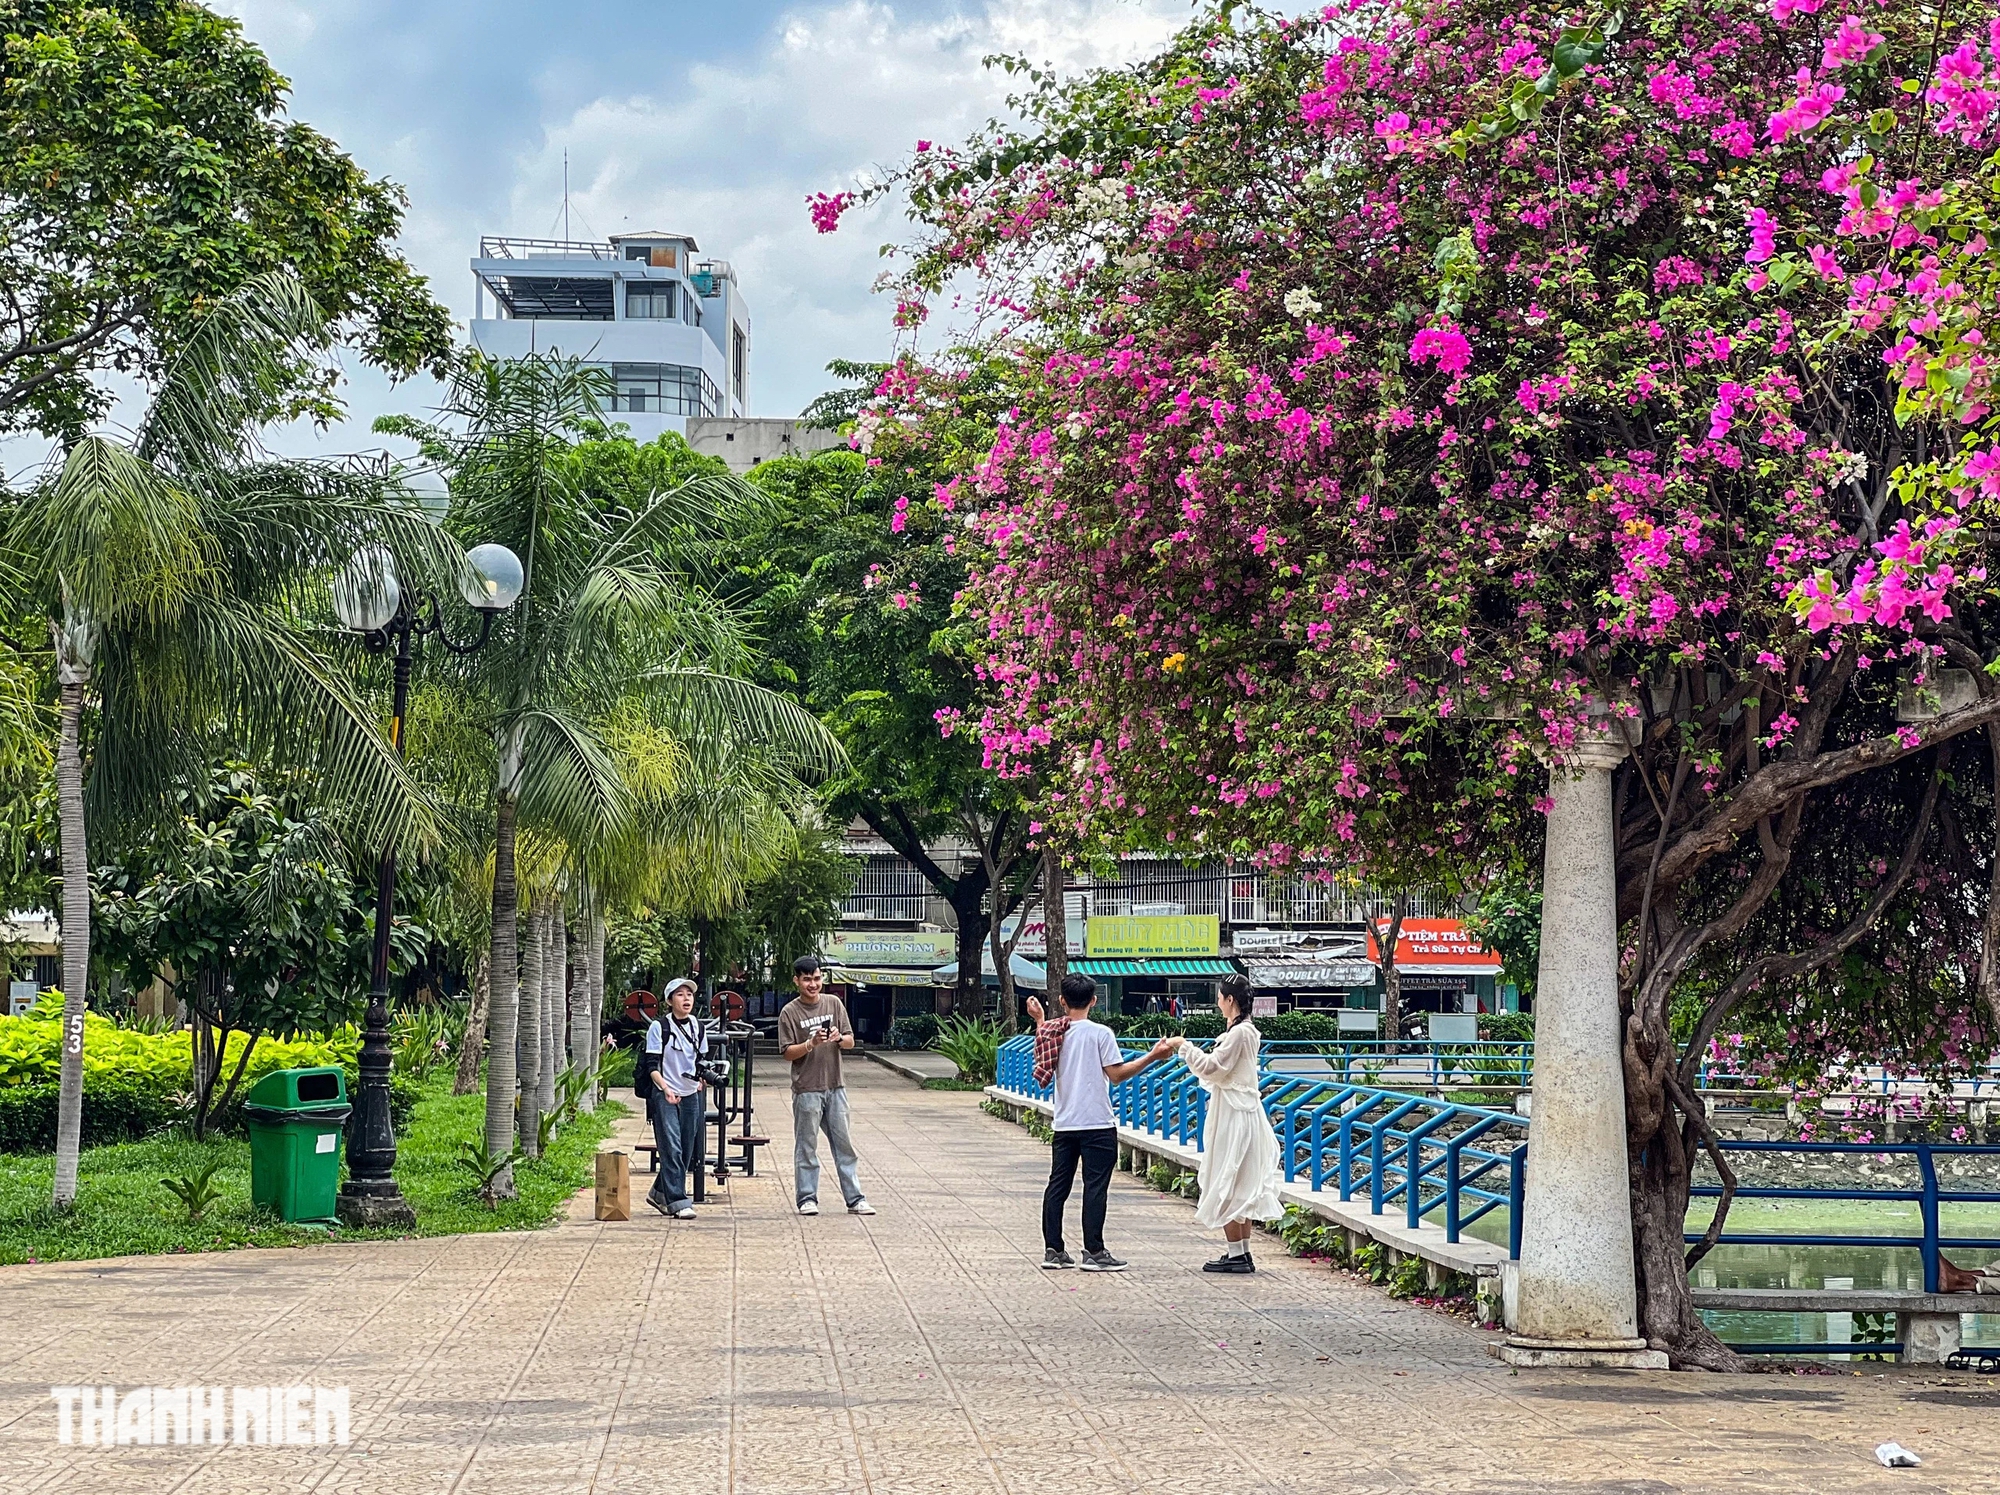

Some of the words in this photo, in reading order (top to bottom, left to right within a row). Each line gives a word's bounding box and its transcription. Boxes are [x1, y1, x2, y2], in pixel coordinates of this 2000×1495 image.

[1407, 929, 1438, 943] TIỆM
[1441, 930, 1468, 942] TRÀ
[845, 941, 901, 953] PHƯƠNG
[904, 942, 935, 953] NAM
[1155, 946, 1163, 954] Vịt
[1412, 944, 1430, 954] Trà
[1431, 944, 1450, 954] Sữa
[1451, 944, 1465, 955] Tự
[1467, 944, 1489, 954] Ch
[1437, 976, 1453, 984] SỮA
